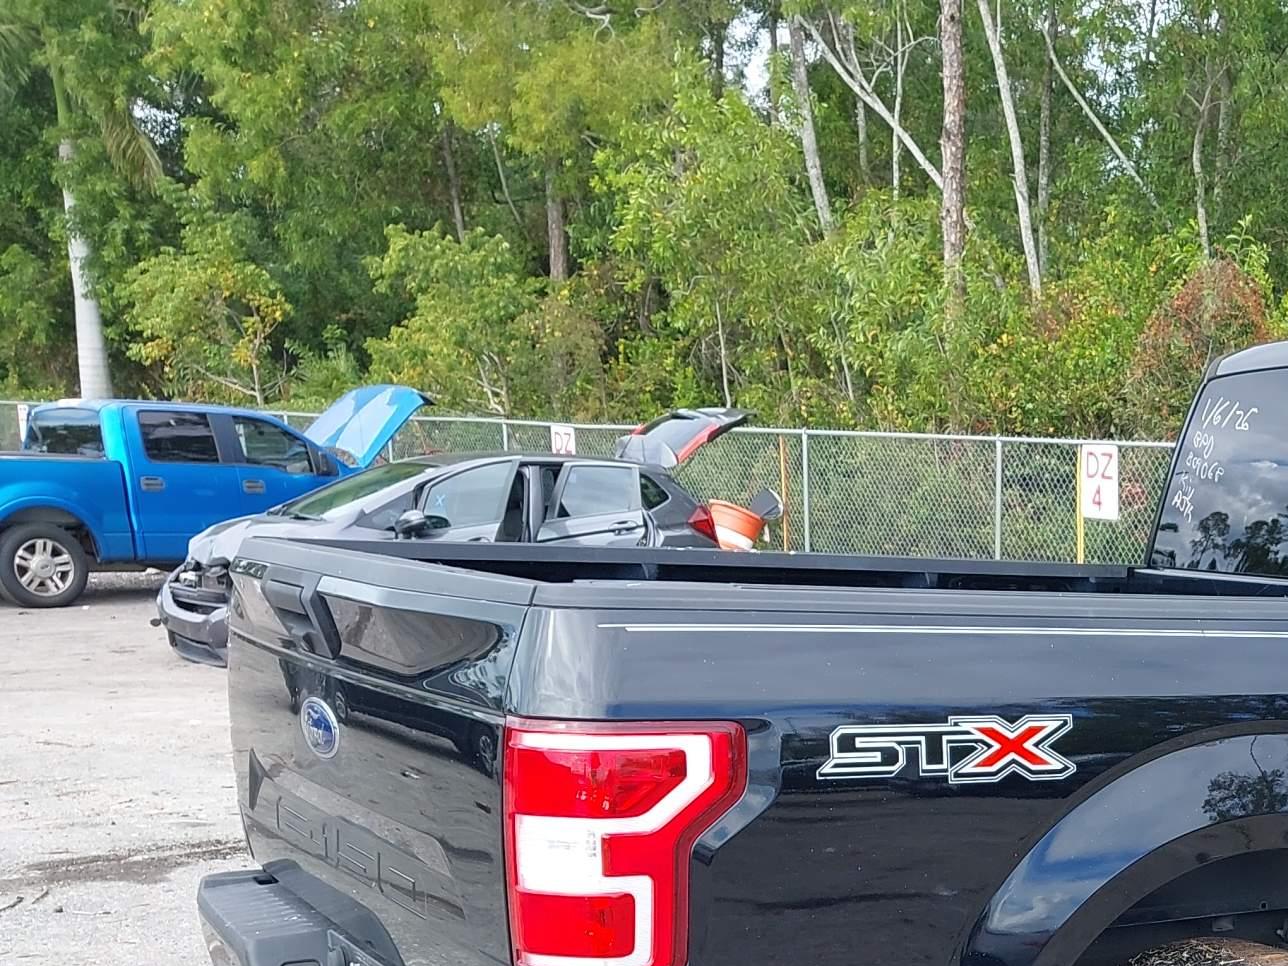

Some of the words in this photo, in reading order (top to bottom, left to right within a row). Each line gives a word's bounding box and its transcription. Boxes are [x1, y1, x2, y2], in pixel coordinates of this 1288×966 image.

[1086, 451, 1113, 480] DZ
[1092, 484, 1103, 512] 4
[815, 713, 1077, 784] STX
